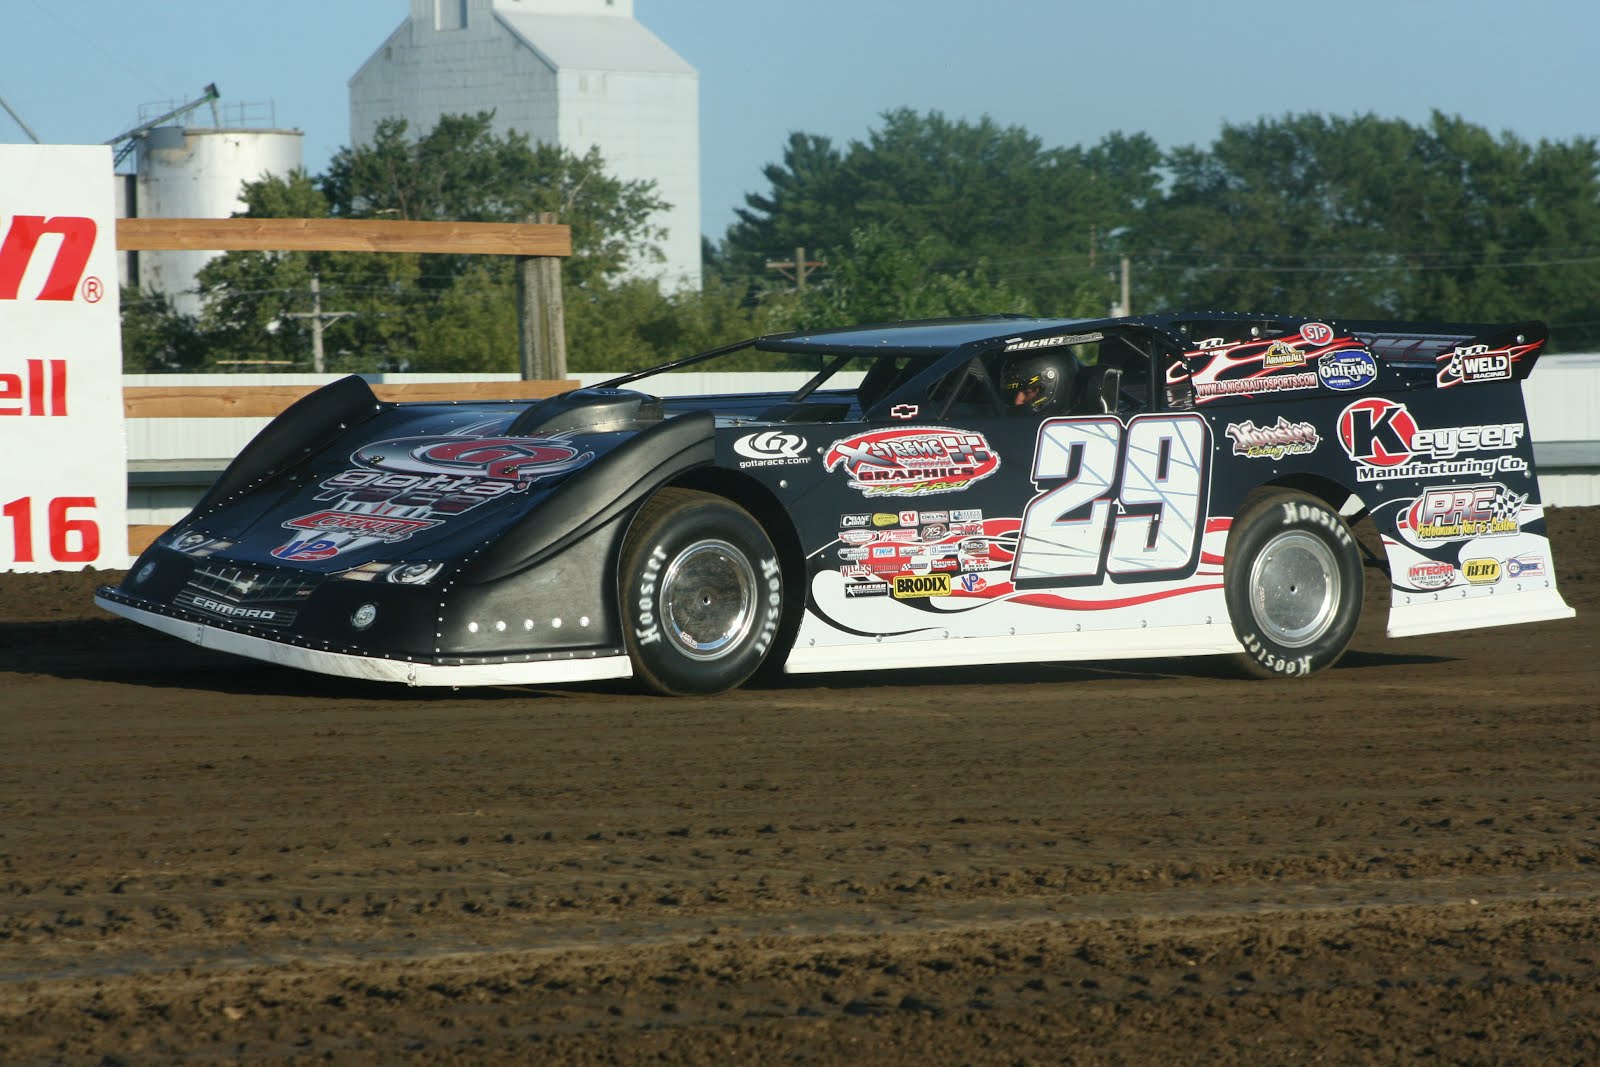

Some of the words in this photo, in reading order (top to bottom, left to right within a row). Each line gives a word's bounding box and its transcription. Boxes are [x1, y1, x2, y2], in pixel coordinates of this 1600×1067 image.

[1306, 326, 1327, 340] STP
[1464, 356, 1508, 374] WELD
[1473, 371, 1506, 379] RACING
[1227, 418, 1317, 447] Hoosier
[1348, 403, 1524, 459] Keyser
[739, 457, 809, 469] gottarace.com
[1357, 460, 1498, 482] Manufacturing
[1498, 456, 1528, 472] Co.
[858, 466, 975, 481] GRAPHICS
[1012, 416, 1208, 582] 29
[1423, 488, 1497, 525] PRC
[902, 513, 915, 522] CV
[1282, 502, 1352, 546] Hoosier
[3, 496, 100, 562] 16
[926, 527, 941, 536] XS
[1416, 522, 1461, 539] Performance
[1462, 520, 1477, 536] Rod
[1480, 520, 1488, 533] &
[1490, 517, 1518, 533] Custom
[839, 564, 872, 578] WILES
[1408, 564, 1454, 577] INTEGRA
[1467, 564, 1498, 577] BERT
[897, 576, 948, 593] BRODIX
[961, 573, 979, 592] VP
[635, 545, 667, 646] Hoosier
[192, 596, 276, 620] CAMARO
[755, 556, 780, 656] Hoosier
[1243, 633, 1313, 678] Hoosier
